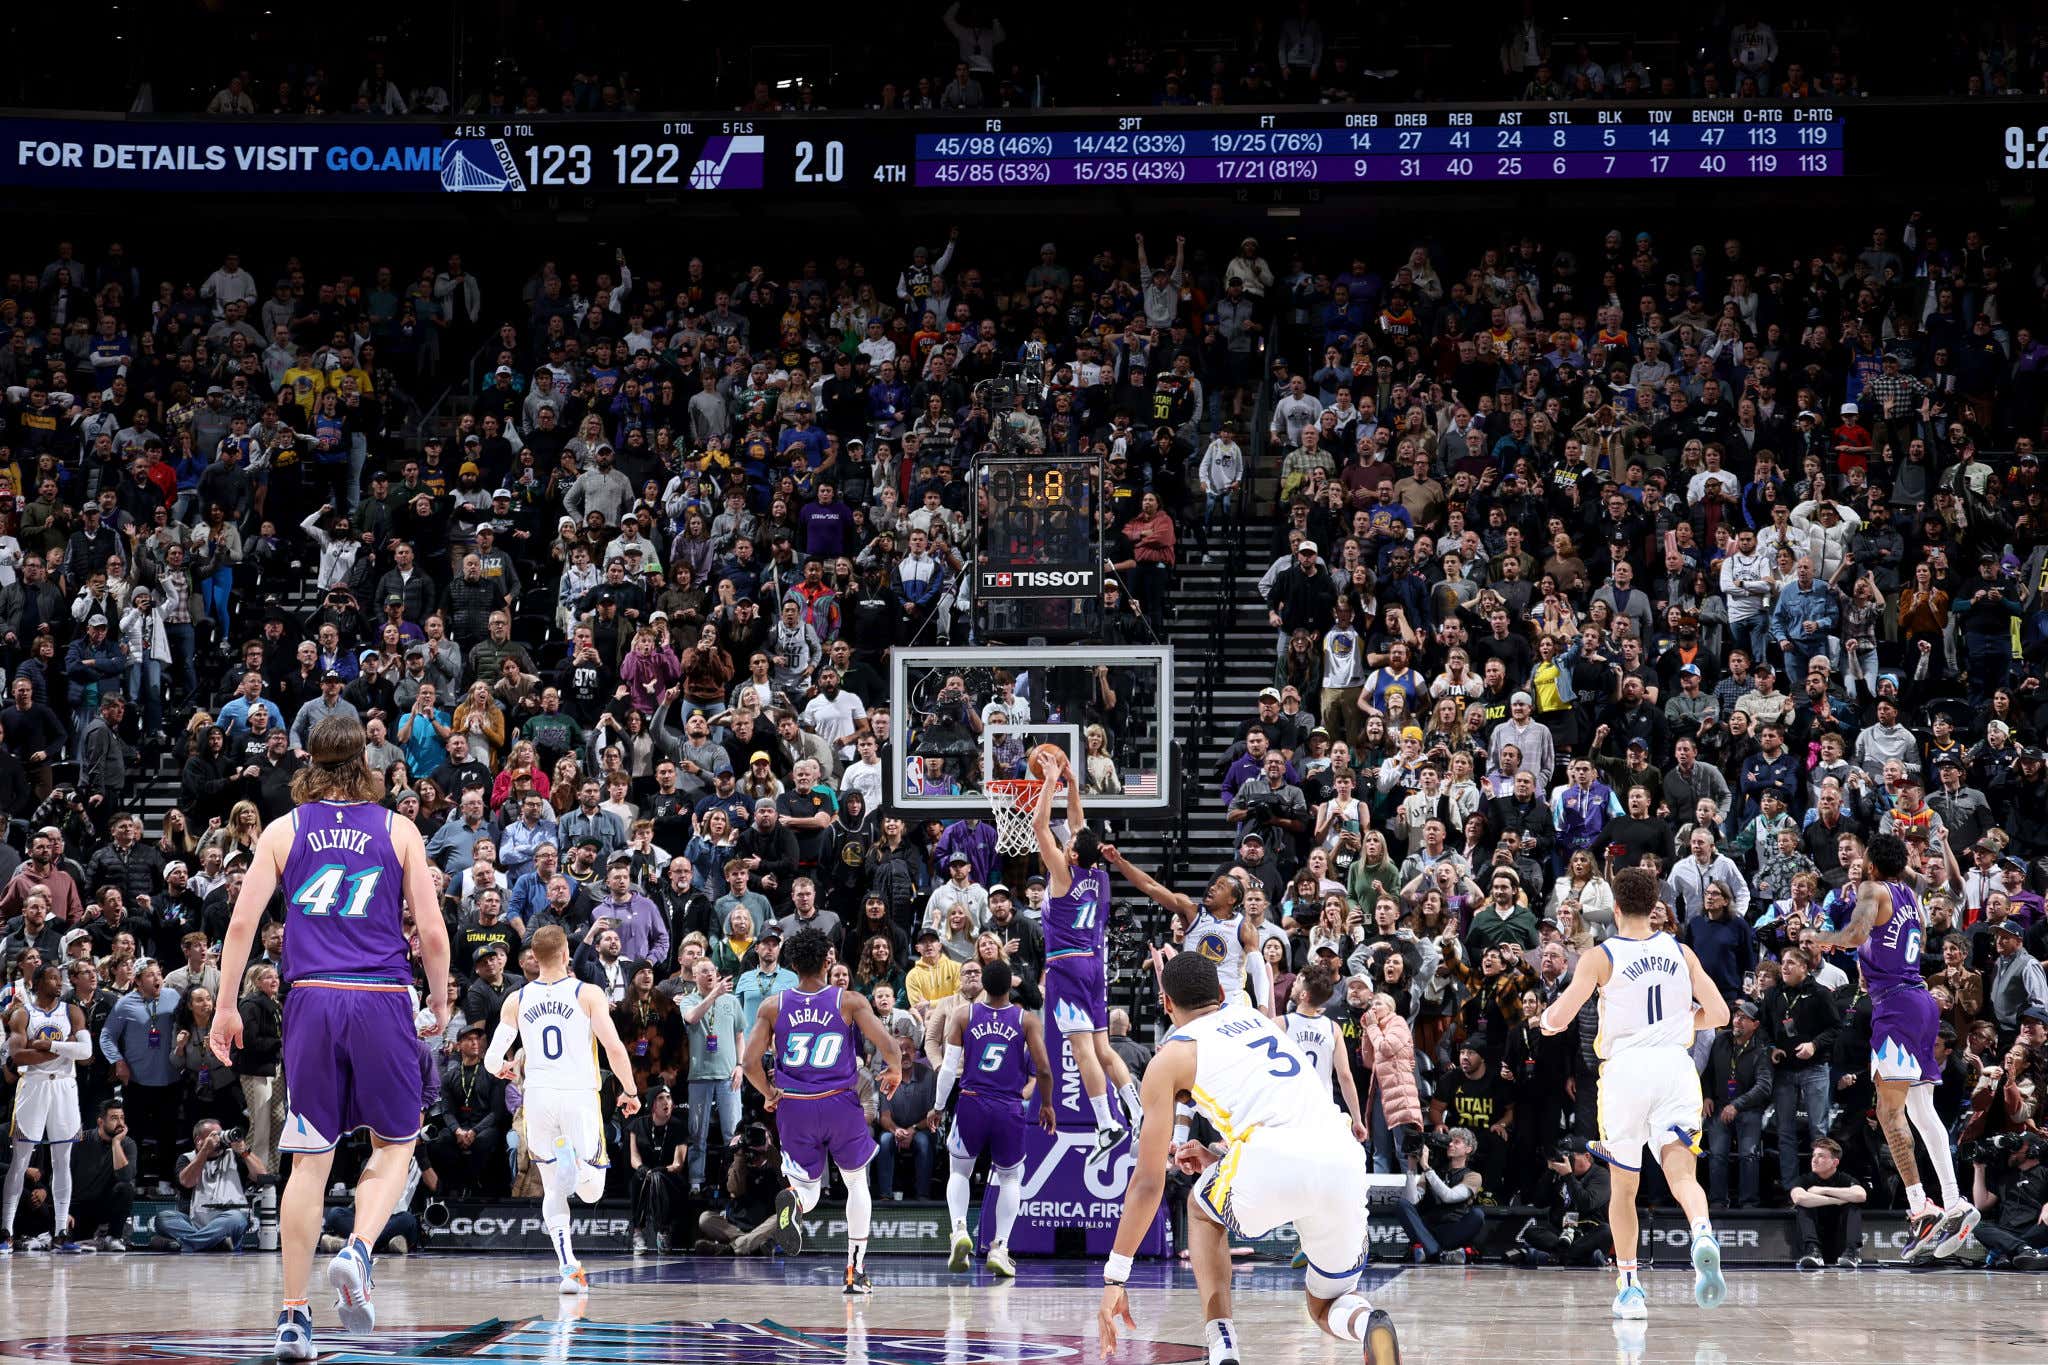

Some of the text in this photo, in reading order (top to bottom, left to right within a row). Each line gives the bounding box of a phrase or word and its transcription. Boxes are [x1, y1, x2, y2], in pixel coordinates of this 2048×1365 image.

[455, 126, 486, 137] 4 FLS
[503, 125, 534, 137] 0 TOL
[663, 123, 694, 135] 0 TOL
[722, 122, 753, 134] 5 FLS
[986, 108, 1833, 132] FG 3PT FT OREB DREB REB AST STL BLK TOV BENCH O-RTG D-RTG
[935, 127, 1827, 156] 45/98 (46%) 14/42 (33%) 19/25 (76%) 14 27 41 24 8 5 14 47 113 119
[18, 140, 83, 168] FOR
[93, 143, 226, 171] DETAILS
[234, 145, 319, 171] VISIT
[494, 142, 522, 189] BONUS
[525, 145, 591, 184] 123
[613, 143, 679, 184] 122
[795, 141, 843, 182] 2.0
[873, 165, 906, 182] 4TH
[935, 155, 1827, 182] 45/85 (53%) 15/35 (43%) 17/21 (81%) 9 31 40 25 6 7 17 40 119 113
[1027, 470, 1064, 500] 1.8
[1013, 571, 1094, 587] TISSOT
[1412, 806, 1435, 818] UTA
[307, 828, 373, 855] OLYNYK
[292, 863, 385, 918] 41
[467, 932, 506, 942] UTAH JAZZ
[1904, 928, 1922, 964] 6
[1622, 956, 1679, 981] THOMPSON
[524, 1000, 574, 1024] DIVINCENZO
[1647, 983, 1664, 1025] 11
[788, 1008, 834, 1027] AGBAJI
[542, 1025, 563, 1060] 0
[971, 1021, 1018, 1041] BEASLEY
[1296, 1030, 1326, 1046] JEROME
[783, 1032, 844, 1068] 30
[978, 1043, 1009, 1071] 5
[1246, 1035, 1301, 1077] 3
[1455, 1097, 1493, 1114] UTAH
[1017, 1201, 1125, 1219] MERICA FIR
[828, 1220, 938, 1238] PWER
[1031, 1220, 1112, 1229] CREDIT UNION
[1641, 1228, 1760, 1248] POER
